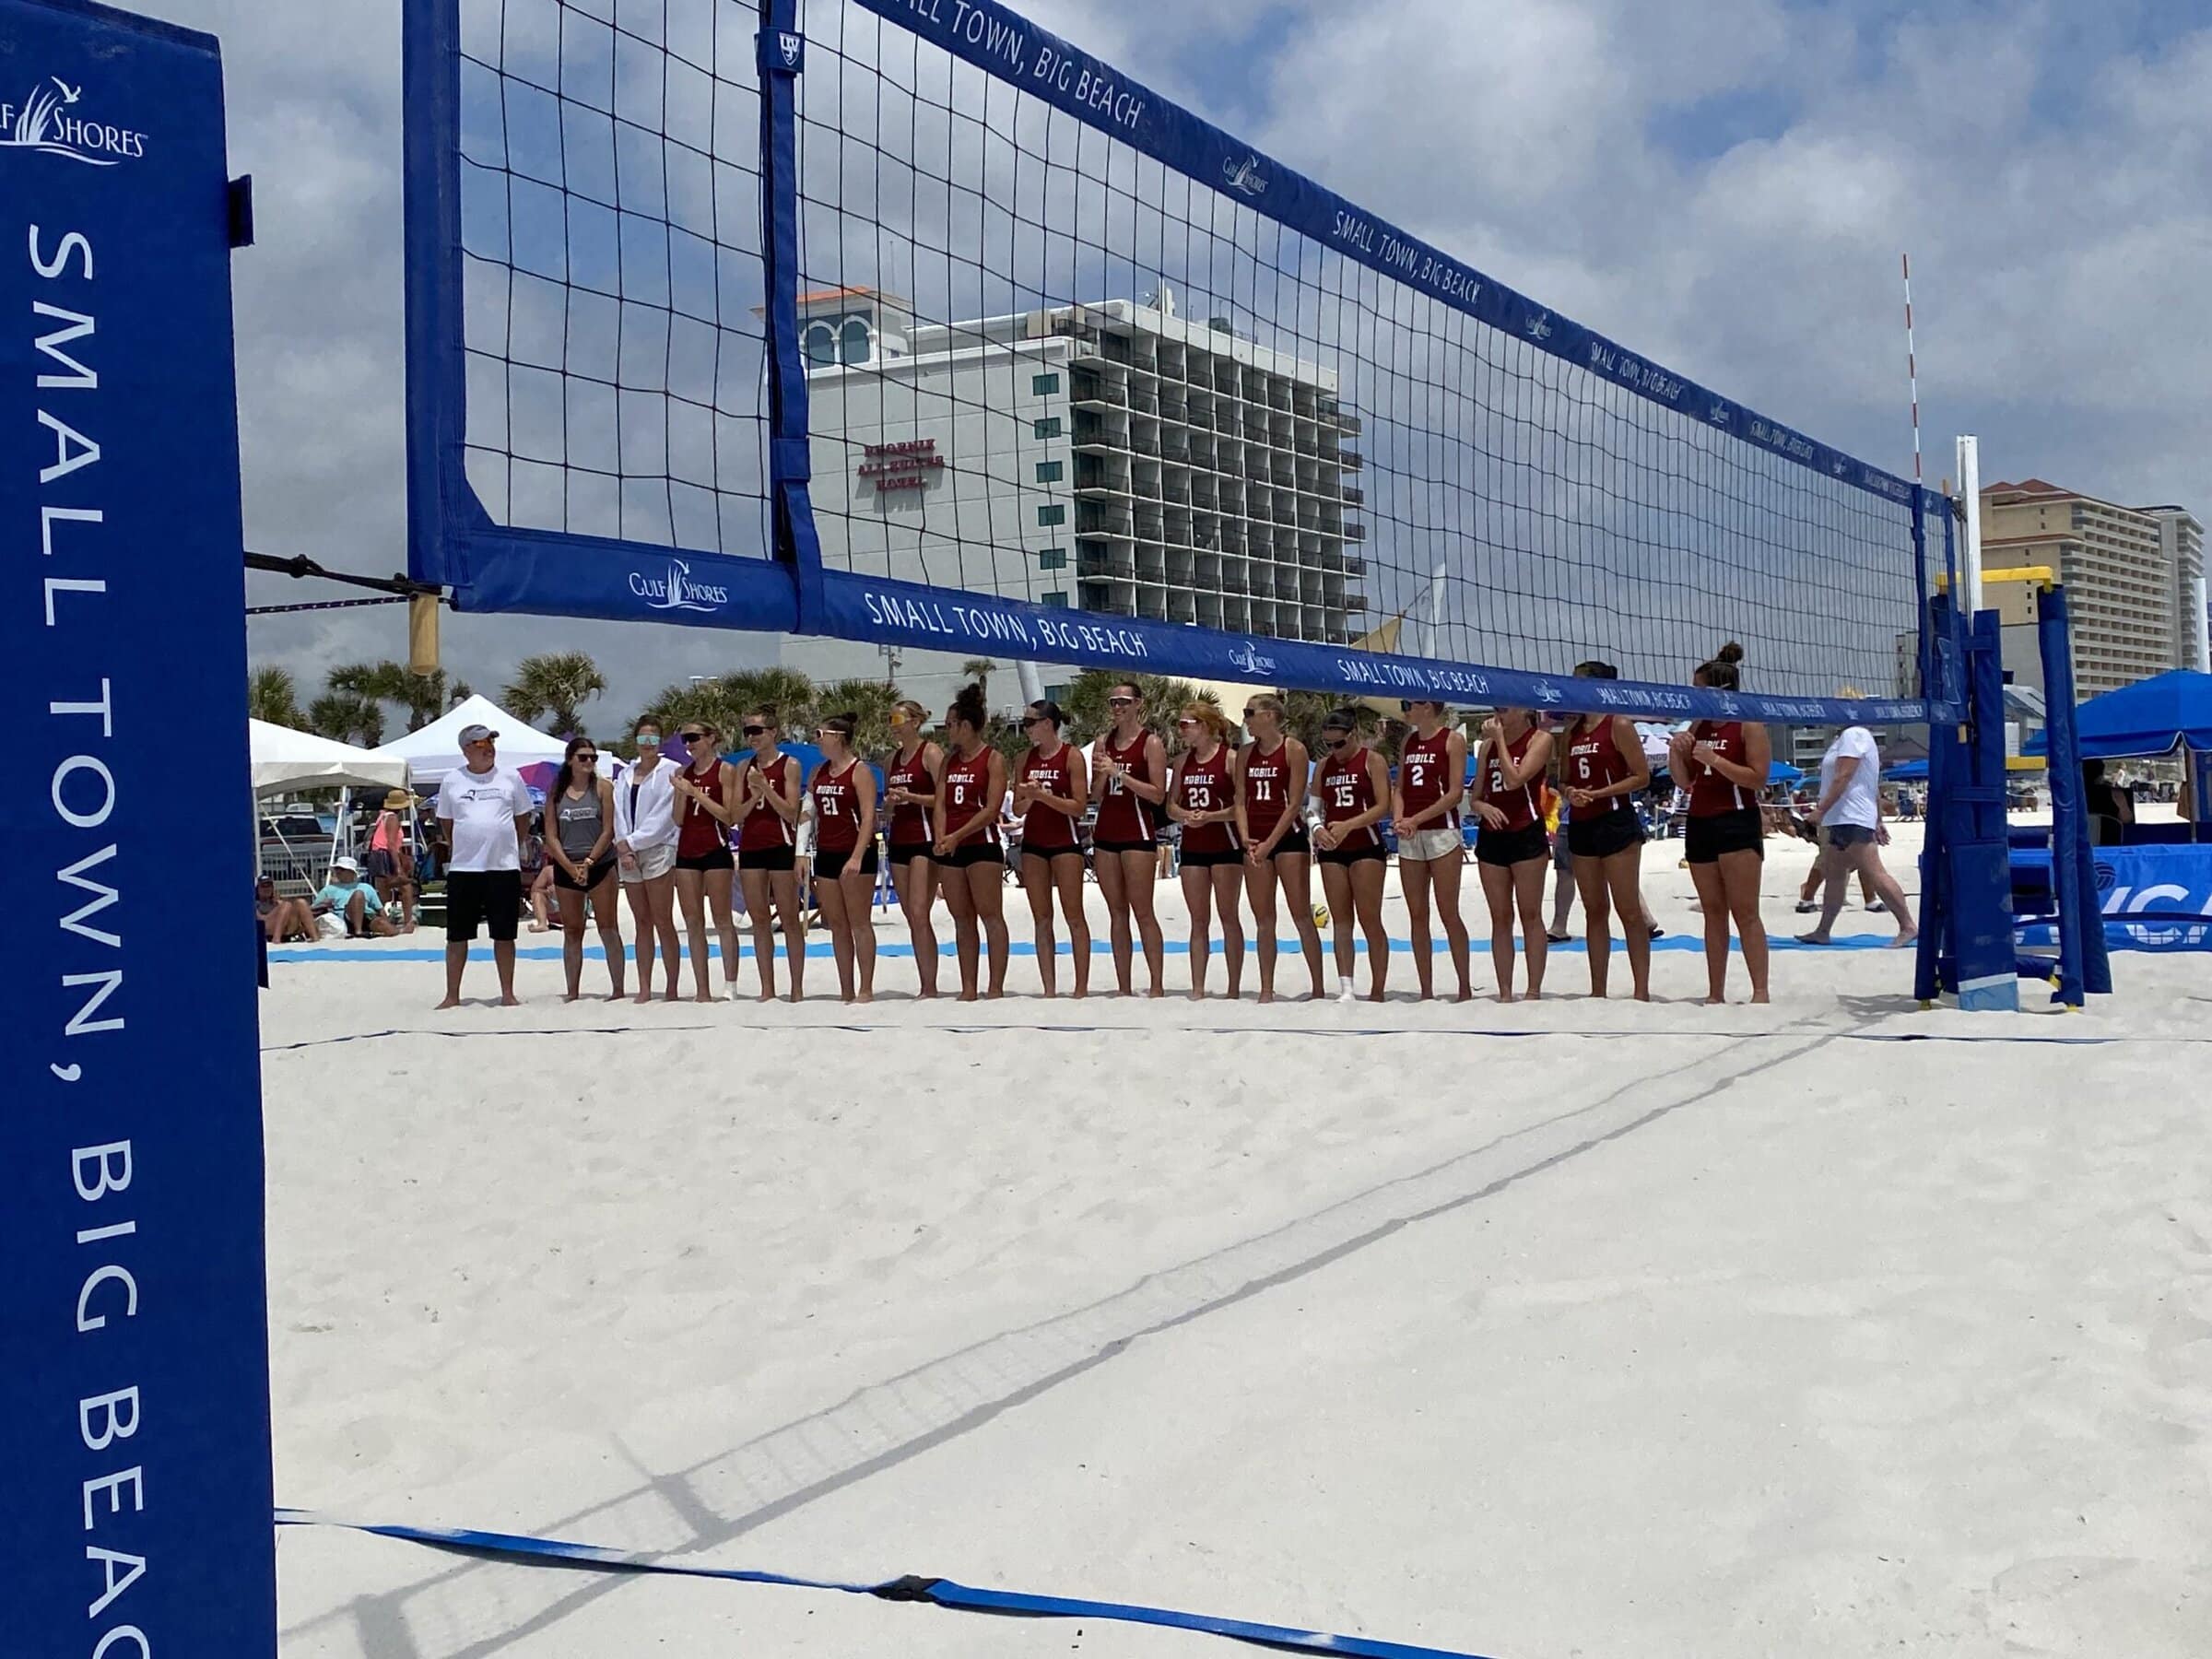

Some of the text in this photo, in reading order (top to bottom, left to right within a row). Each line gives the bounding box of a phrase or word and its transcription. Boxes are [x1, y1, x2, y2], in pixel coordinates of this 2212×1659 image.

[952, 0, 1025, 76] TOWN,
[1035, 47, 1069, 90] BIG
[1076, 70, 1140, 129] BEACH
[53, 107, 144, 158] SHORES
[1334, 210, 1373, 253] SMALL
[1422, 257, 1442, 285] BIG
[1442, 268, 1480, 302] BEACH
[29, 223, 107, 627] SMALL
[865, 593, 1148, 657] SMALL TOWN, BIG BEACH
[1336, 659, 1490, 695] SMALL TOWN, BIG BEACH
[1405, 753, 1436, 764] MOBILE
[1579, 757, 1590, 779] 6
[947, 773, 975, 783] MOBILE
[1028, 770, 1059, 780] MOBILE
[1183, 774, 1215, 784] MOBILE
[1249, 766, 1277, 778] MOBILE
[1325, 773, 1359, 787] MOBILE
[1411, 765, 1424, 786] 2
[816, 784, 845, 795] MOBILE
[954, 785, 965, 805] 8
[1188, 787, 1210, 807] 23
[1256, 781, 1271, 801] 11
[1335, 786, 1355, 807] 15
[821, 796, 839, 816] 21
[50, 677, 125, 1082] TOWN,
[71, 1139, 138, 1333] BIG
